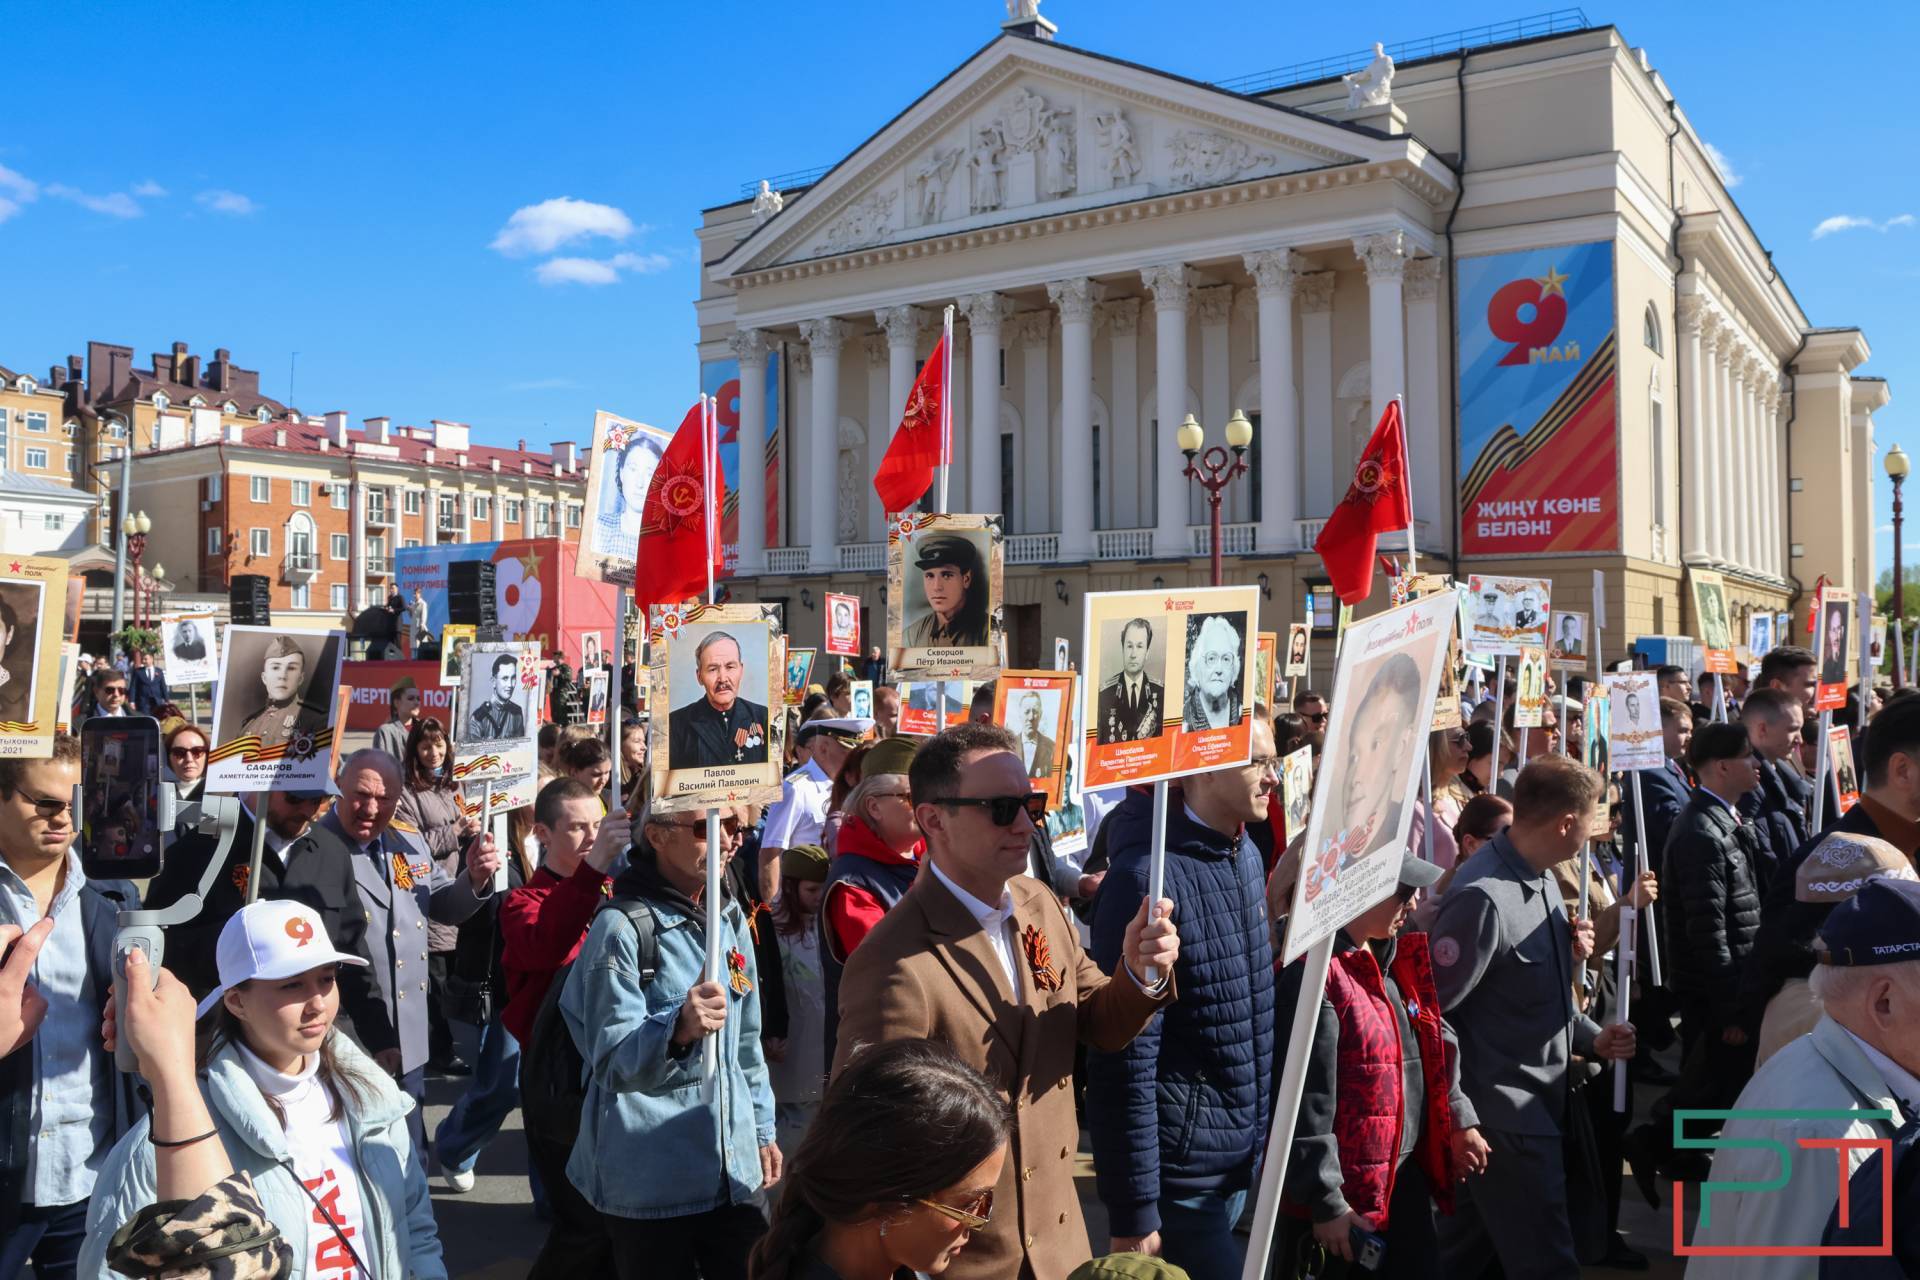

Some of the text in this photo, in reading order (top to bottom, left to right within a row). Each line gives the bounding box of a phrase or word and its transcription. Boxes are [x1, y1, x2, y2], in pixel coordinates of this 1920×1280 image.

[1529, 341, 1580, 364] МАЙ
[1543, 497, 1601, 514] КӨНЕ
[1478, 520, 1552, 537] БЕЛӘН!
[402, 564, 440, 575] ПОМНИМ!
[926, 648, 964, 657] Скворцов
[916, 658, 935, 666] Пётр
[246, 763, 292, 771] САФАРОВ
[704, 768, 736, 778] Павлов
[678, 777, 760, 791] Василий Павлович
